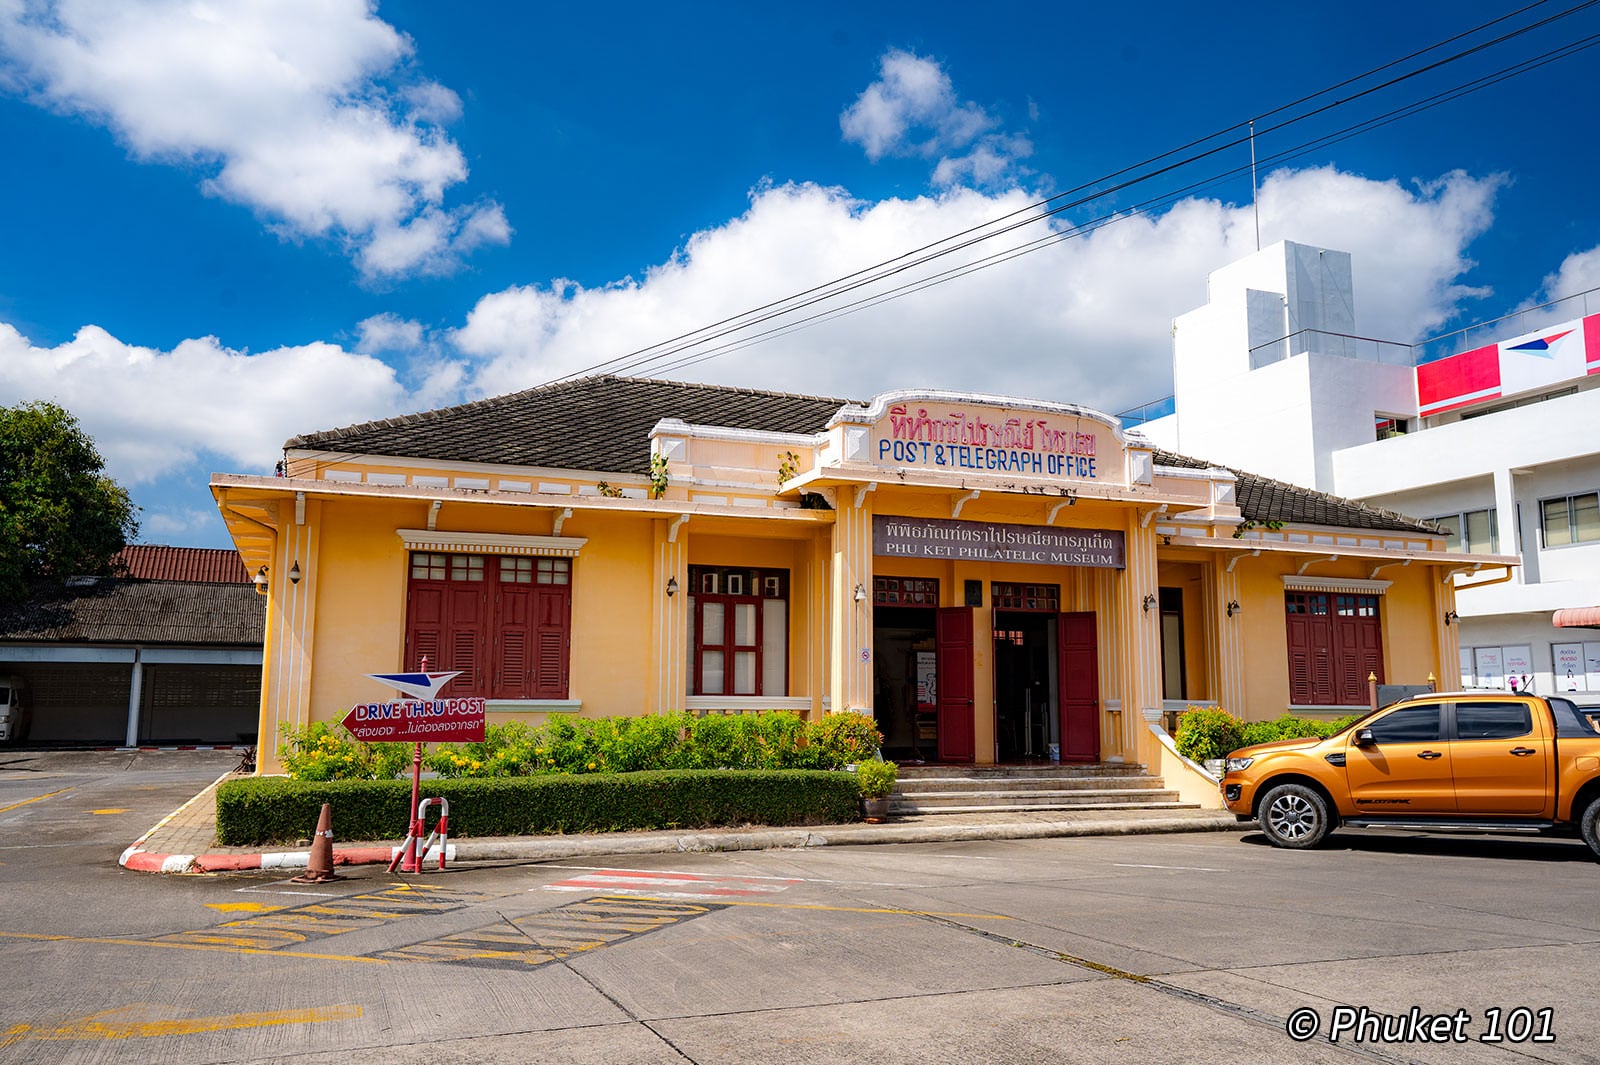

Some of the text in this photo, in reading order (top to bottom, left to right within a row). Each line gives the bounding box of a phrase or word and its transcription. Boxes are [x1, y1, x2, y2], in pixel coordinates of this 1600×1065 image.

[1048, 454, 1097, 478] OFFICE
[886, 543, 1113, 565] PHU KET PHILATELIC MUSEUM
[355, 697, 486, 721] DRIVE THRU POST
